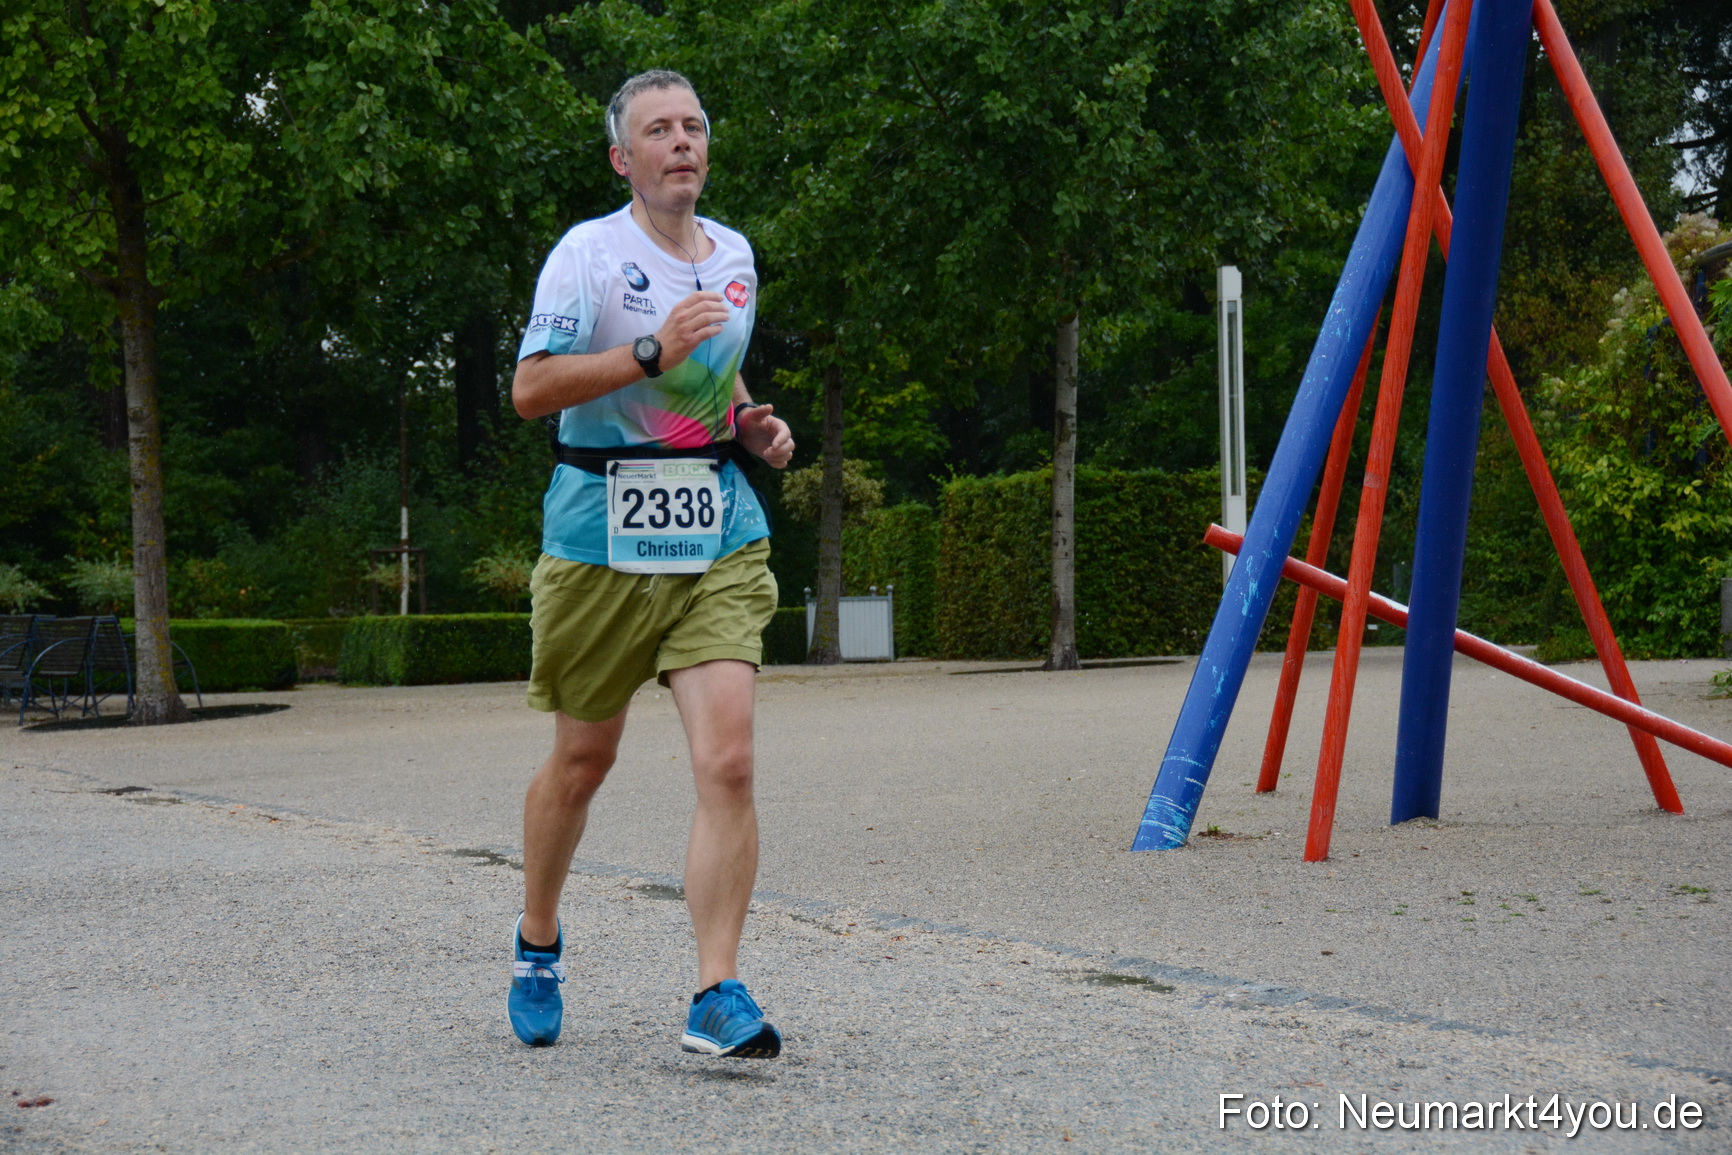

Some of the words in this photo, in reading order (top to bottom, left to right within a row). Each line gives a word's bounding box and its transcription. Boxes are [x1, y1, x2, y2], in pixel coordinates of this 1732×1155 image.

[623, 293, 656, 309] PARTL
[623, 303, 657, 316] Neumarkt
[663, 464, 712, 476] BOCK
[622, 487, 715, 529] 2338
[637, 541, 704, 557] Christian
